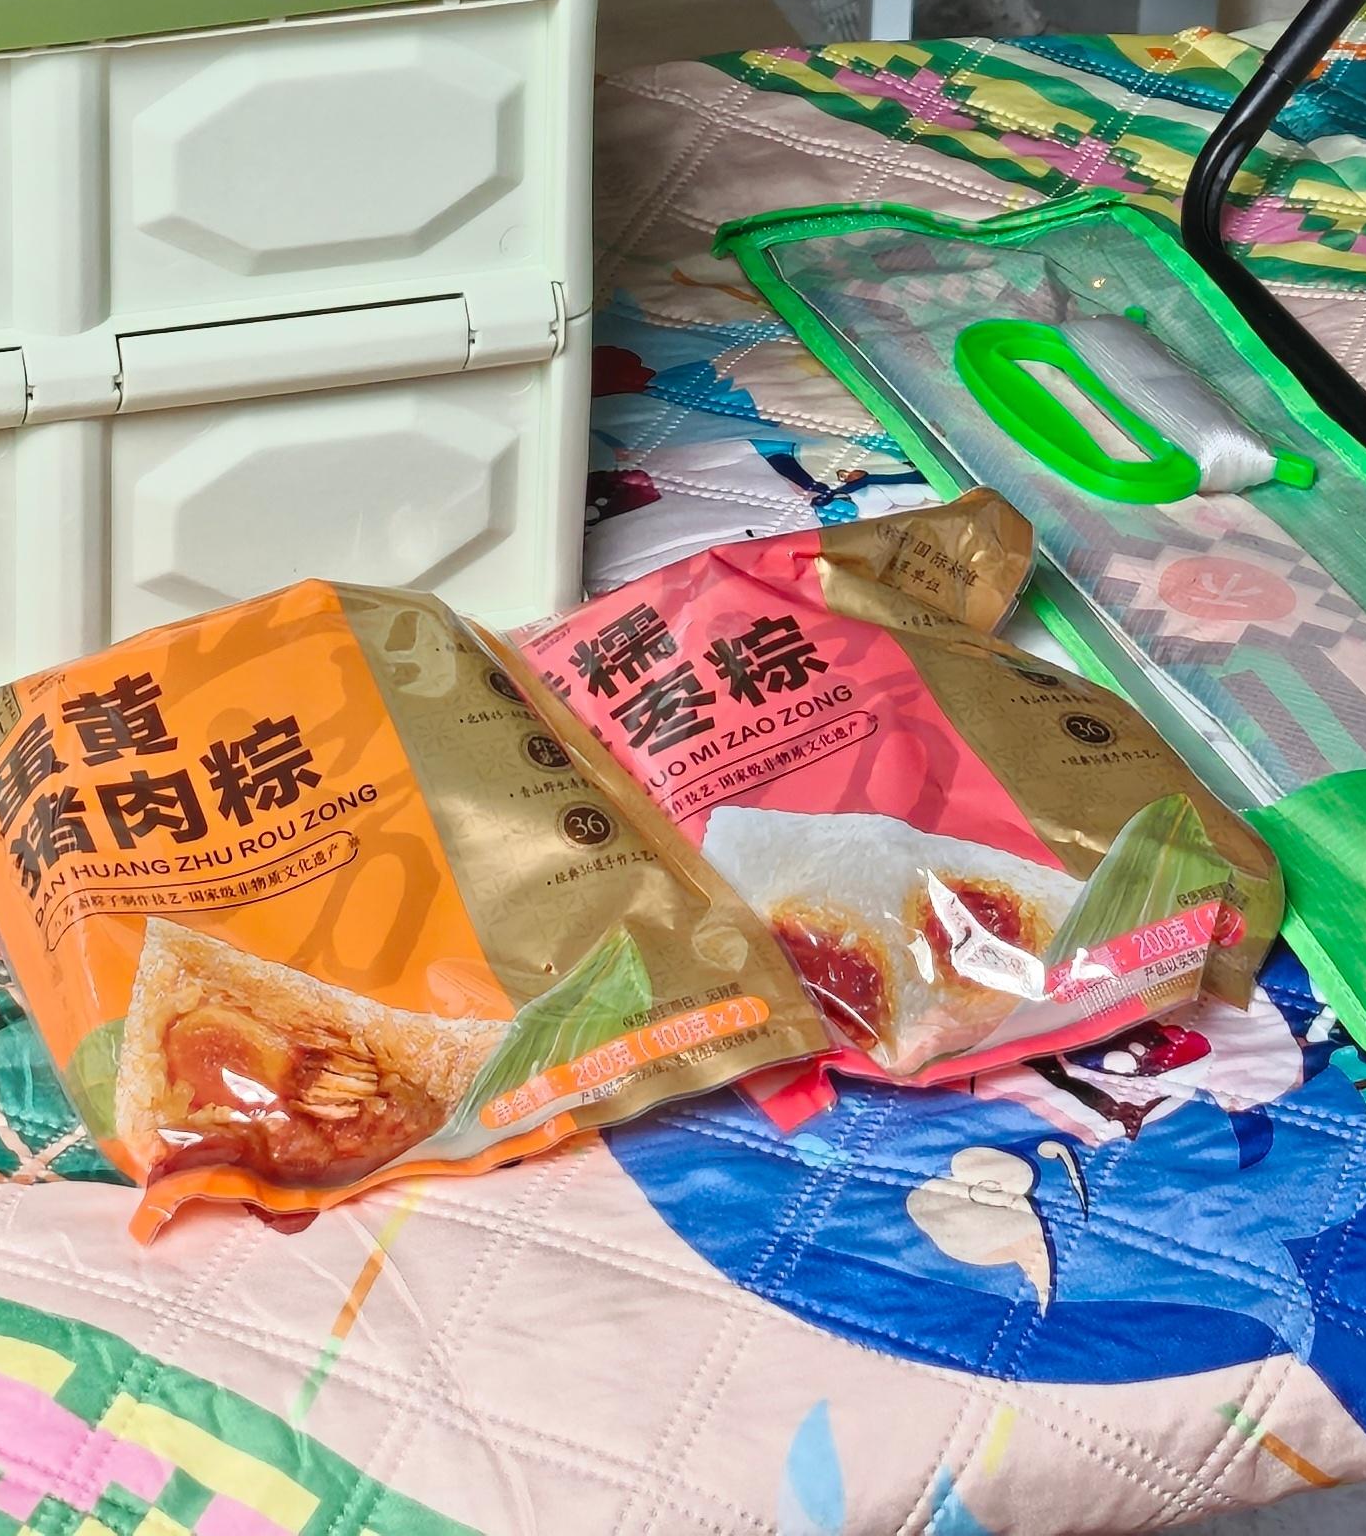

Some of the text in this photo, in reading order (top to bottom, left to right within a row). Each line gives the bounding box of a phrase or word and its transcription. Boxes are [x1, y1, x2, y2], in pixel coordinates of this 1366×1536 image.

[591, 614, 830, 755] 枣粽
[689, 740, 721, 766] MI
[721, 717, 776, 750] ZAO
[777, 684, 853, 726] ZONG
[1070, 720, 1106, 737] 36
[10, 715, 322, 898] 猪肉粽
[35, 783, 378, 928] DAN HUANG ZHU ROU ZONG
[567, 814, 605, 839] 36
